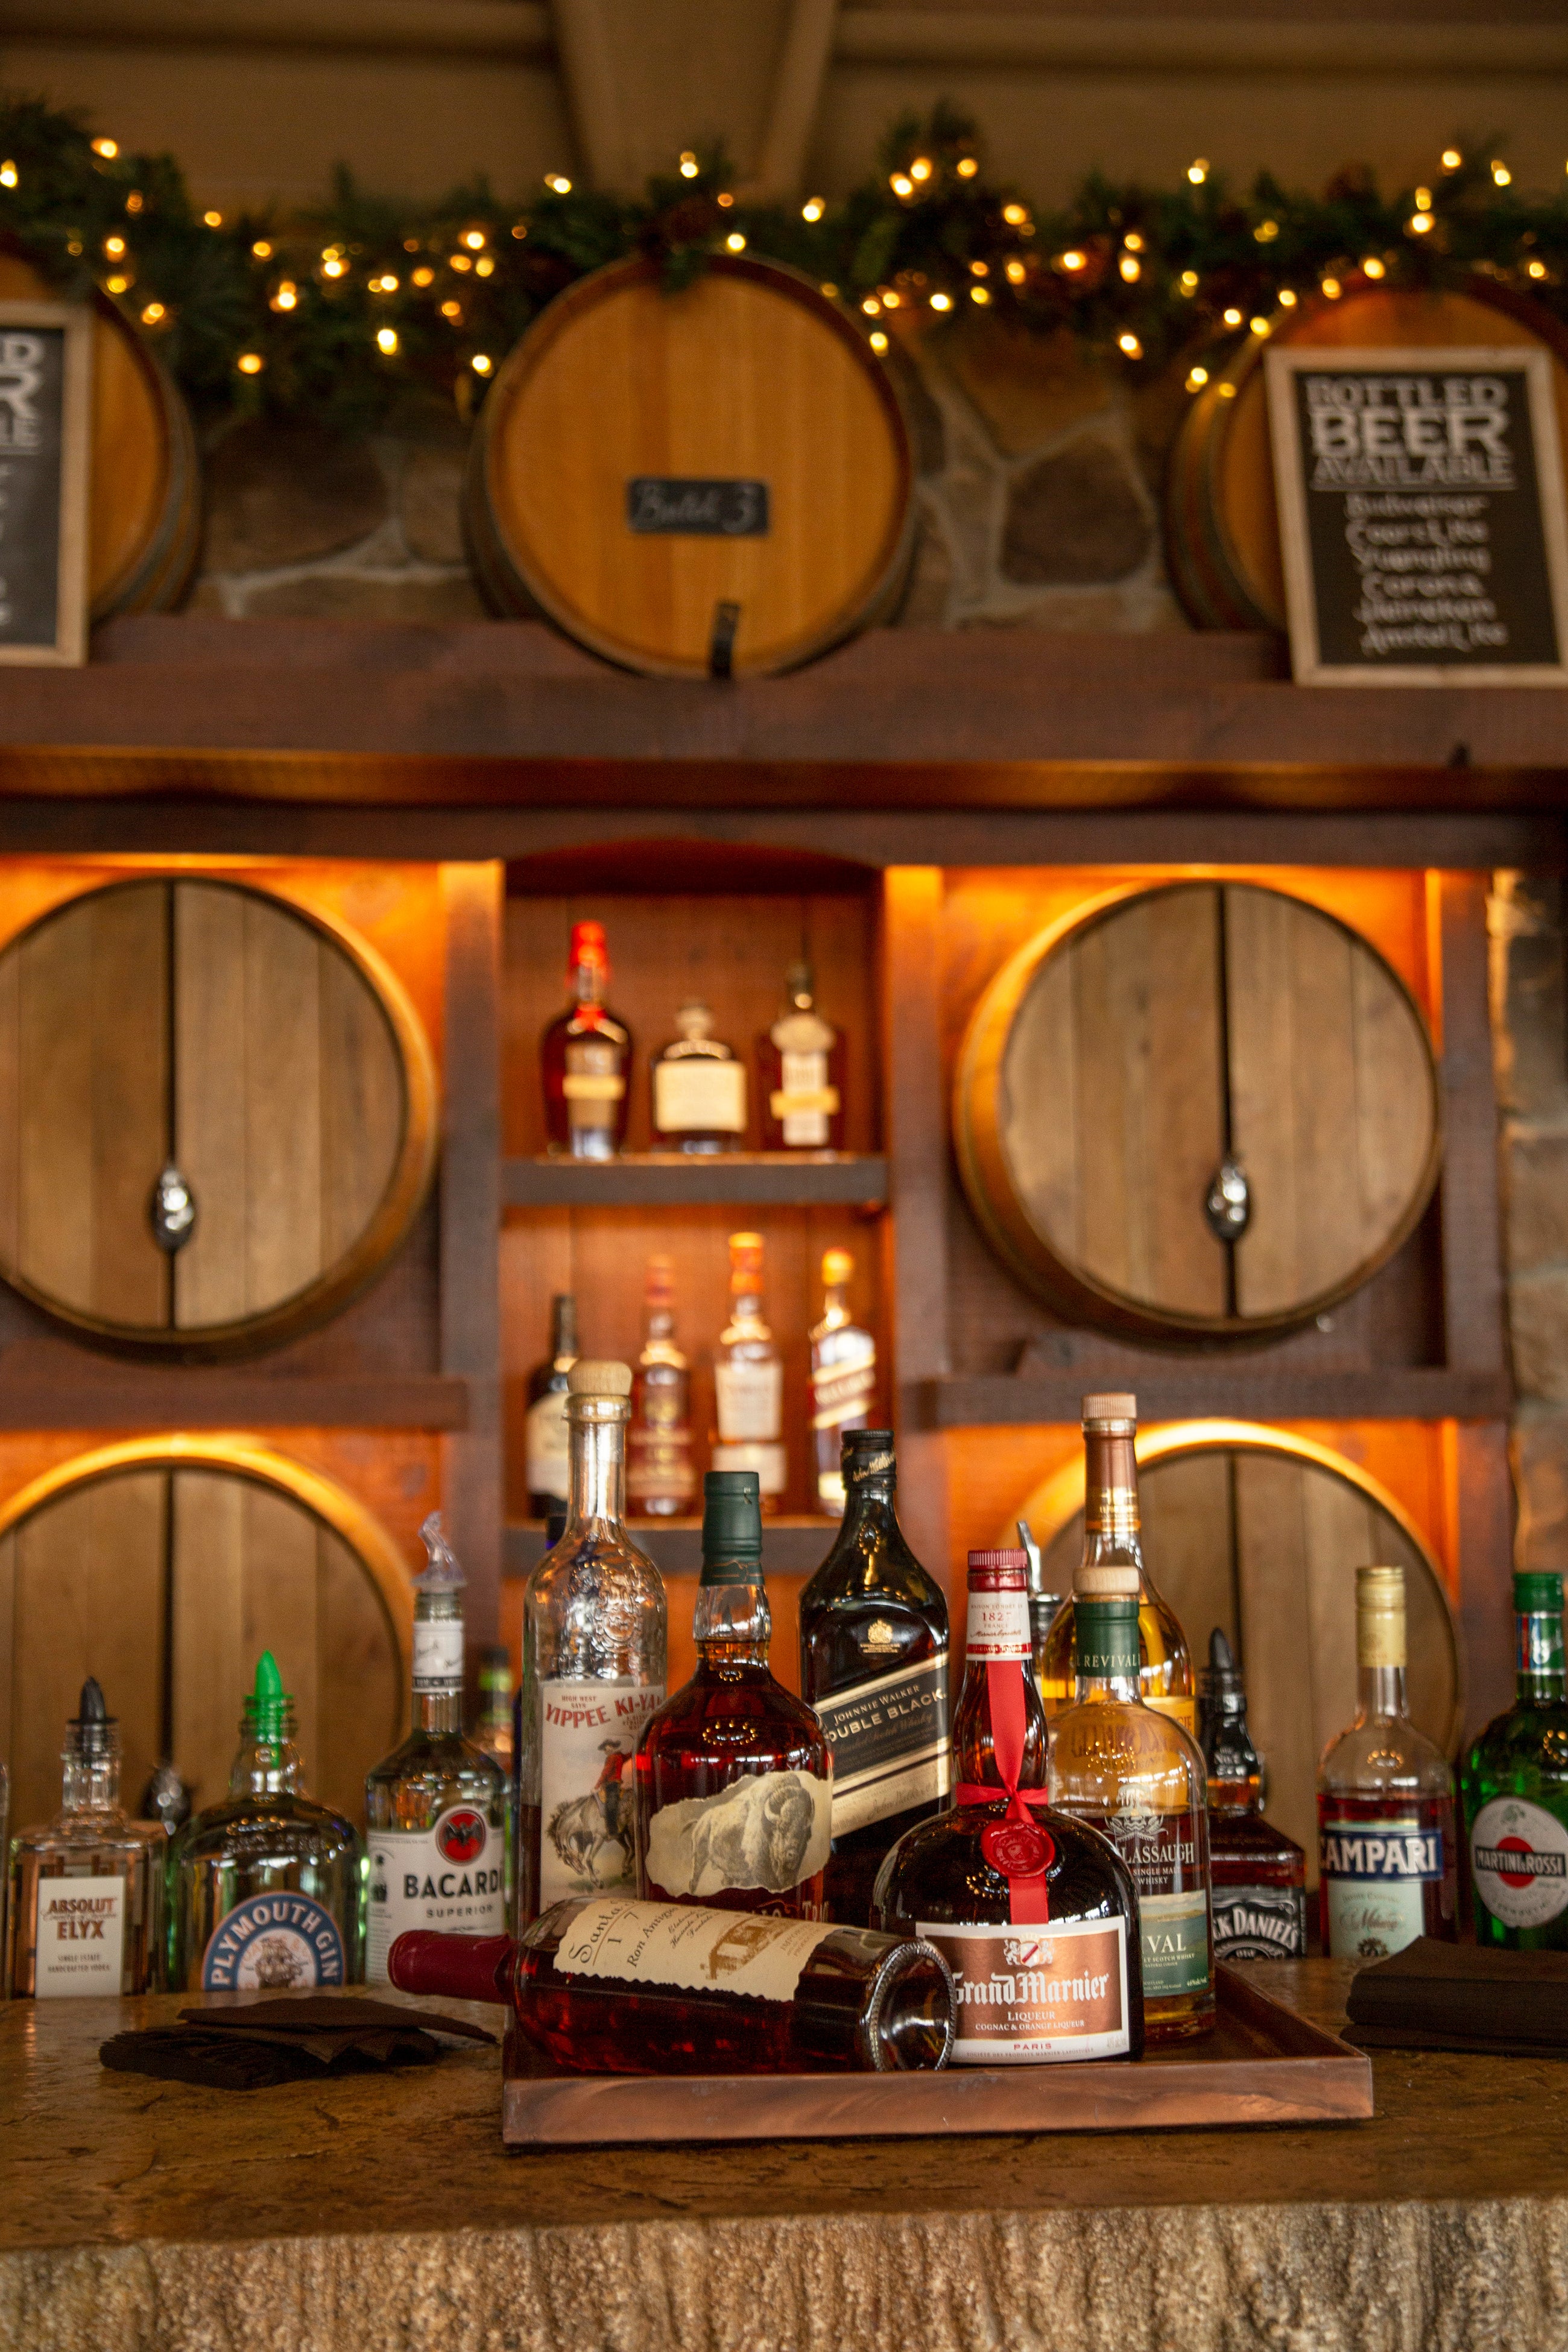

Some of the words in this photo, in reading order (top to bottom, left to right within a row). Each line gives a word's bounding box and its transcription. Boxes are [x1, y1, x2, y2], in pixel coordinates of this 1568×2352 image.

[1306, 378, 1509, 407] BOTTLED
[1310, 407, 1511, 457] BEER
[1313, 455, 1513, 483] AVAILABLE
[1084, 1654, 1137, 1668] REVIVAL
[545, 1703, 611, 1728] YIPPEE
[834, 1699, 879, 1727] JOHNNIE
[879, 1684, 920, 1706] WALKER
[828, 1712, 882, 1742] OUBLE
[1122, 1842, 1195, 1864] LASSAUGH
[1326, 1837, 1438, 1874] AMPARI
[1137, 1876, 1168, 1885] WHISKY
[48, 1898, 116, 1914] ABSOLUT
[426, 1904, 493, 1918] SUPERIOR
[57, 1920, 104, 1941] ELYX
[211, 1901, 322, 1985] PLYMOUTH
[315, 1930, 339, 1977] GIN
[568, 1904, 624, 1964] Santa
[627, 1941, 646, 1968] Ron
[952, 1970, 1016, 2006] Grand
[1014, 1970, 1107, 2005] Marnier
[975, 2023, 1010, 2031] COGNAC
[1019, 2022, 1051, 2031] ORANGE
[1053, 2020, 1085, 2029] LIQUEUR
[1007, 2011, 1055, 2023] LIQUEUR
